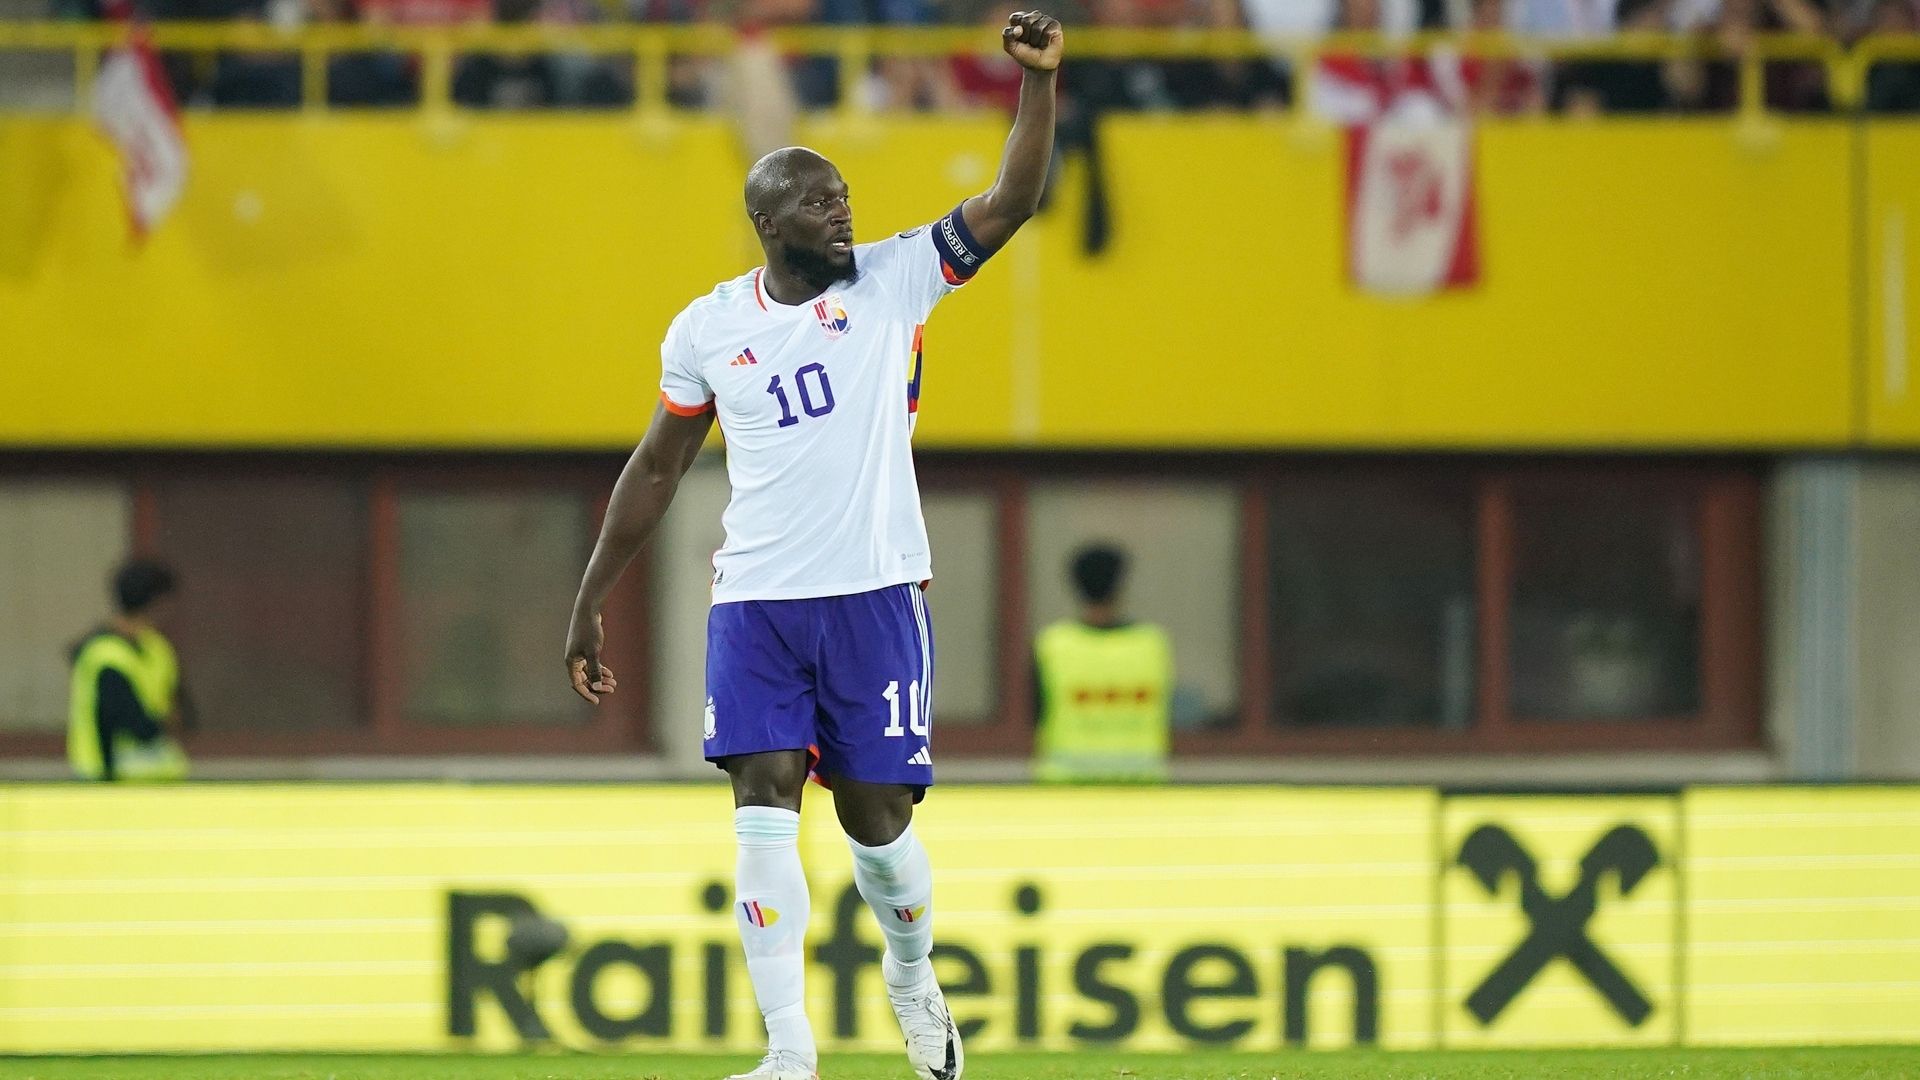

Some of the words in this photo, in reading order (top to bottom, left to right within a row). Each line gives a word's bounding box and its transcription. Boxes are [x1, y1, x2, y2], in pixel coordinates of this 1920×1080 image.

[943, 217, 966, 255] RESPECT
[766, 362, 835, 428] 10
[882, 680, 930, 737] 10
[447, 883, 1379, 1043] Raifeisen
